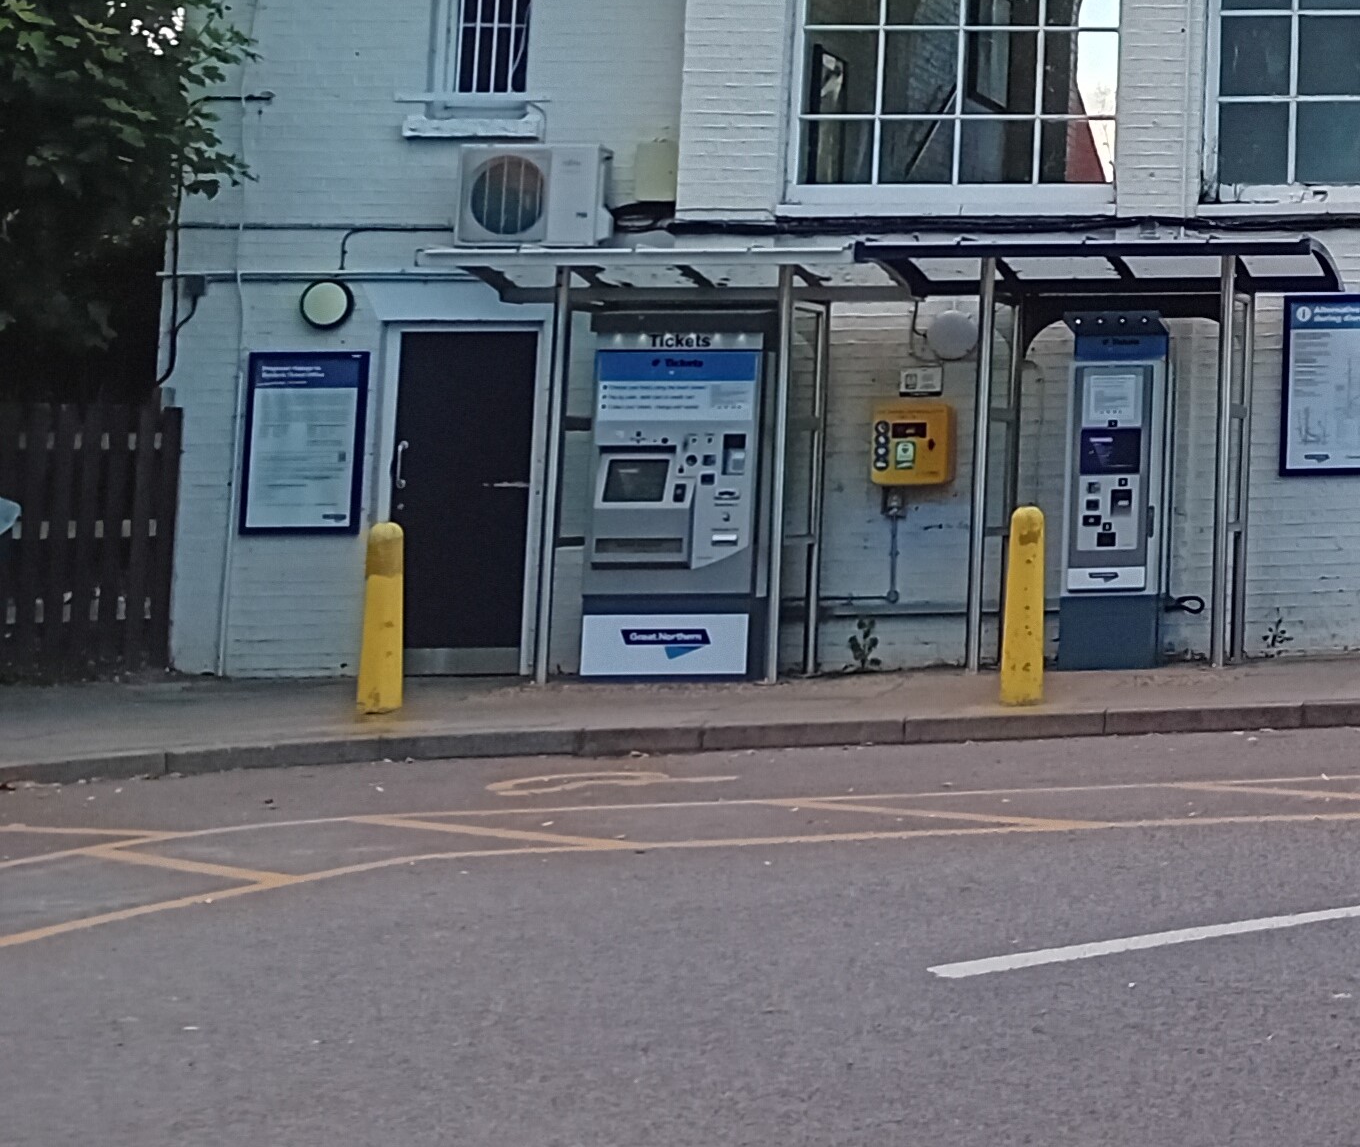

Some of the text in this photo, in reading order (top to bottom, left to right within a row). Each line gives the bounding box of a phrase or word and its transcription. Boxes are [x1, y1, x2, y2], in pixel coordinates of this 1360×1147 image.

[651, 334, 711, 348] Tickets
[629, 632, 702, 641] Great Northern
